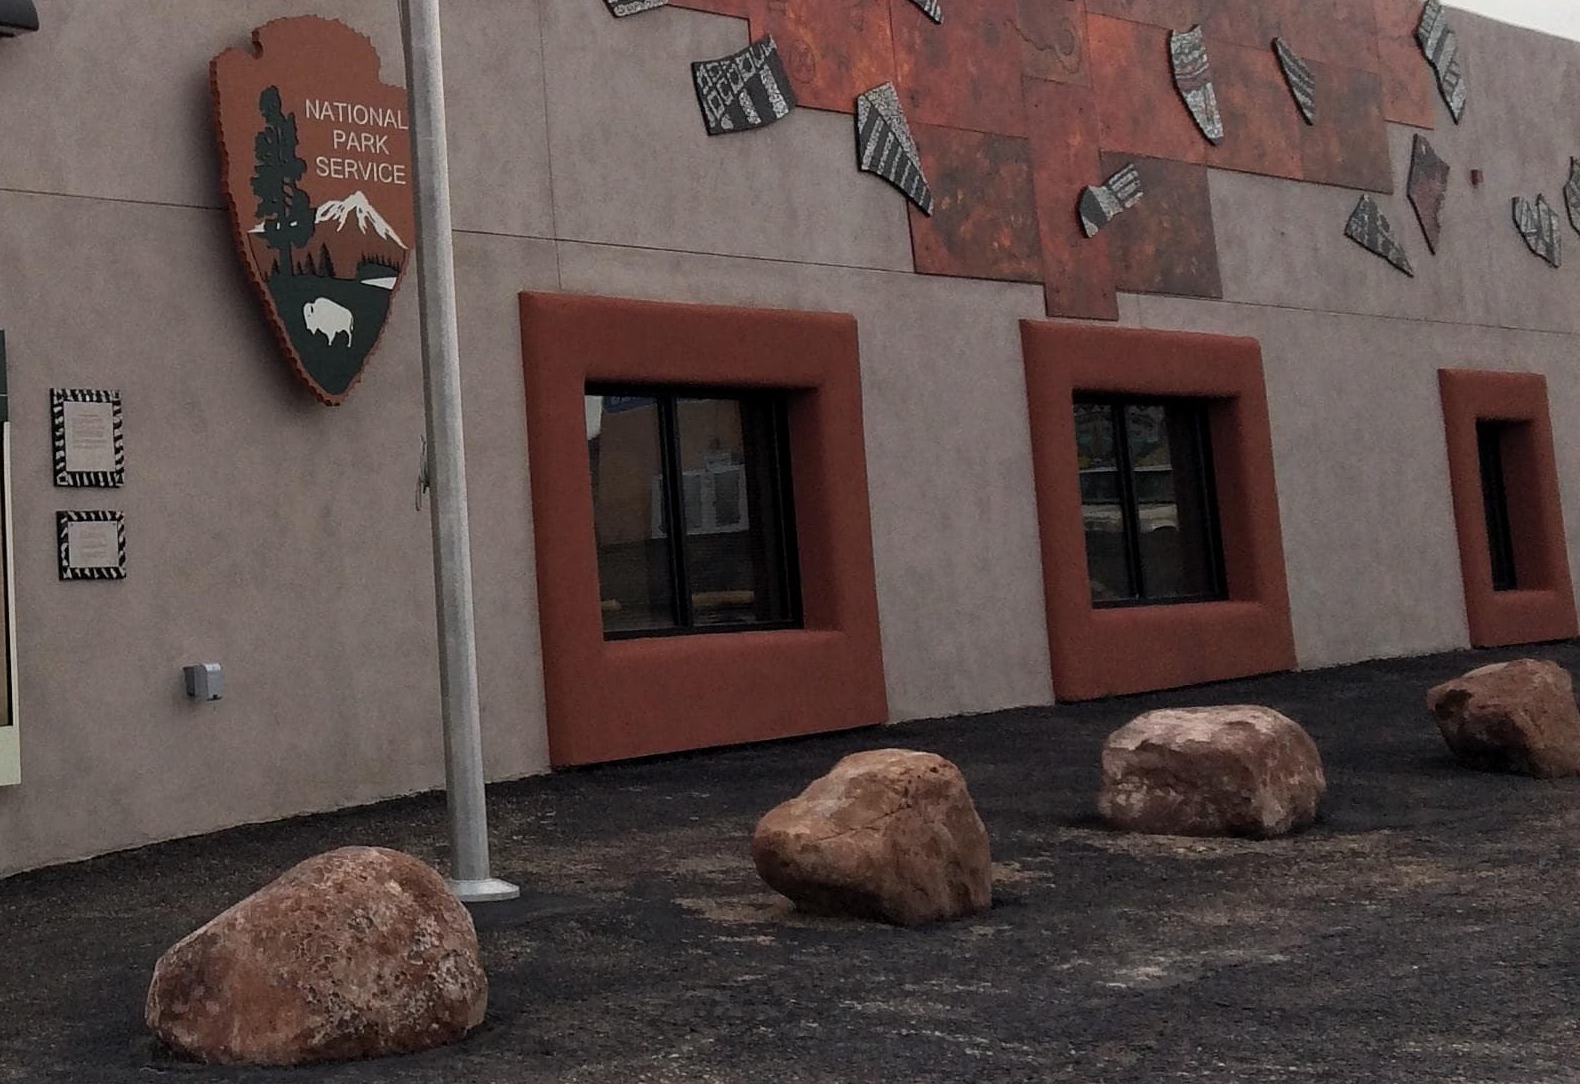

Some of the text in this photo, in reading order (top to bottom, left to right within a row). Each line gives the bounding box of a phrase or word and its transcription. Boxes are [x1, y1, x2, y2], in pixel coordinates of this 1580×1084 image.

[305, 98, 409, 130] NATIONAL
[333, 129, 390, 155] PARK
[316, 156, 407, 185] SERVICE
